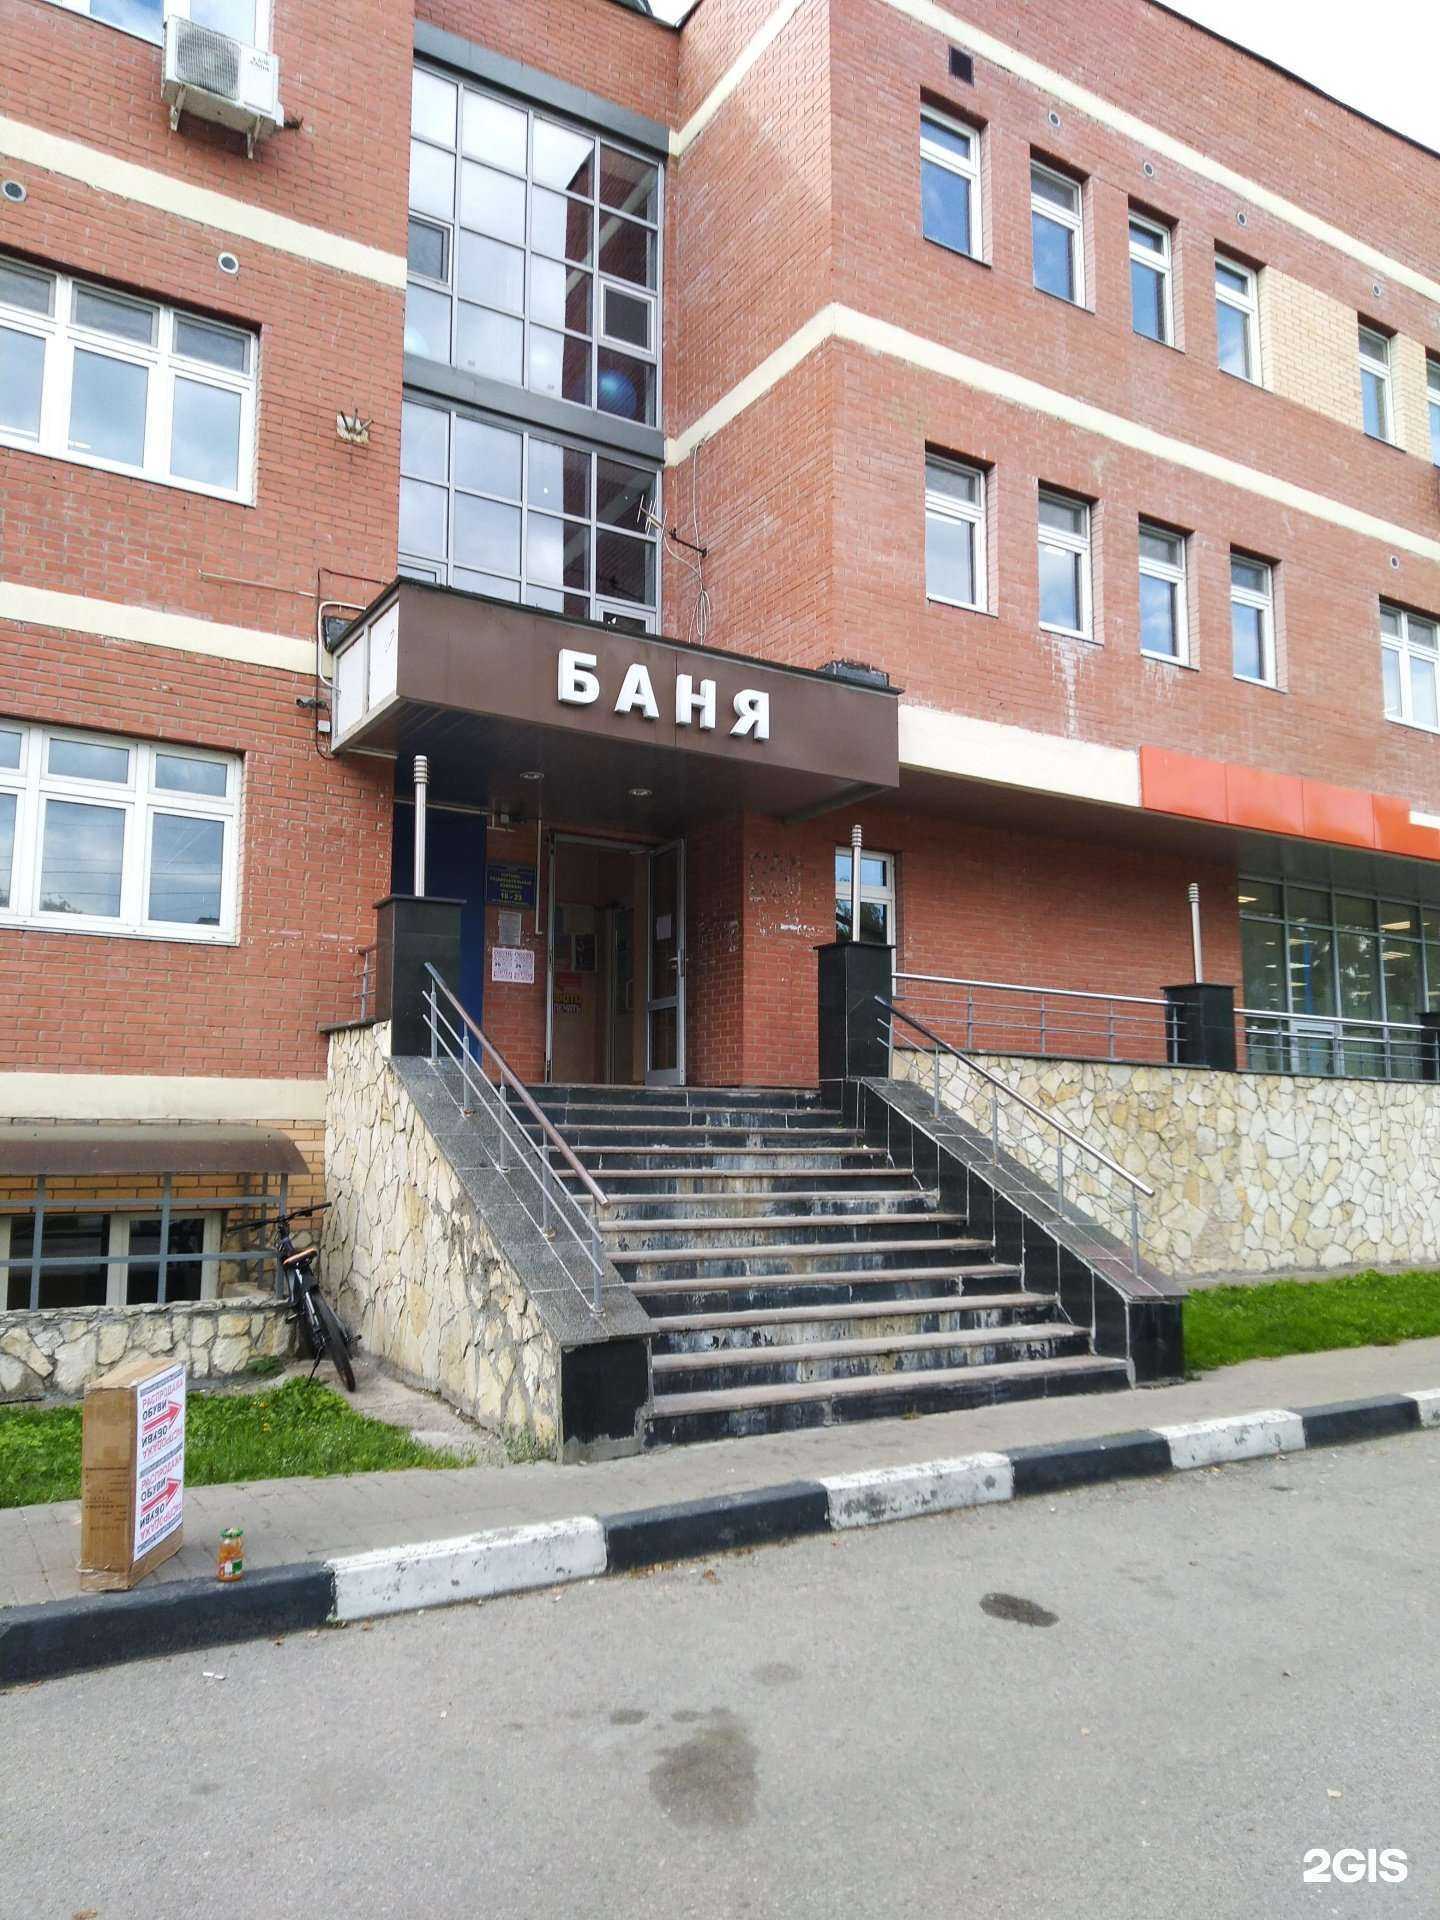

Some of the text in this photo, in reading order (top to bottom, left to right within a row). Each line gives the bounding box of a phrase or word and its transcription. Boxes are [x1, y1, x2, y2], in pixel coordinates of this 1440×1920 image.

[557, 648, 770, 742] БАНЯ
[142, 1378, 184, 1410] РАСПРОДАЖА
[142, 1400, 167, 1420] ОБУВИ
[141, 1425, 168, 1448] ОБУВИ
[141, 1454, 182, 1490] РАСПРОДАЖА
[141, 1478, 166, 1502] ОБУВИ
[140, 1503, 165, 1529] ОБУВИ
